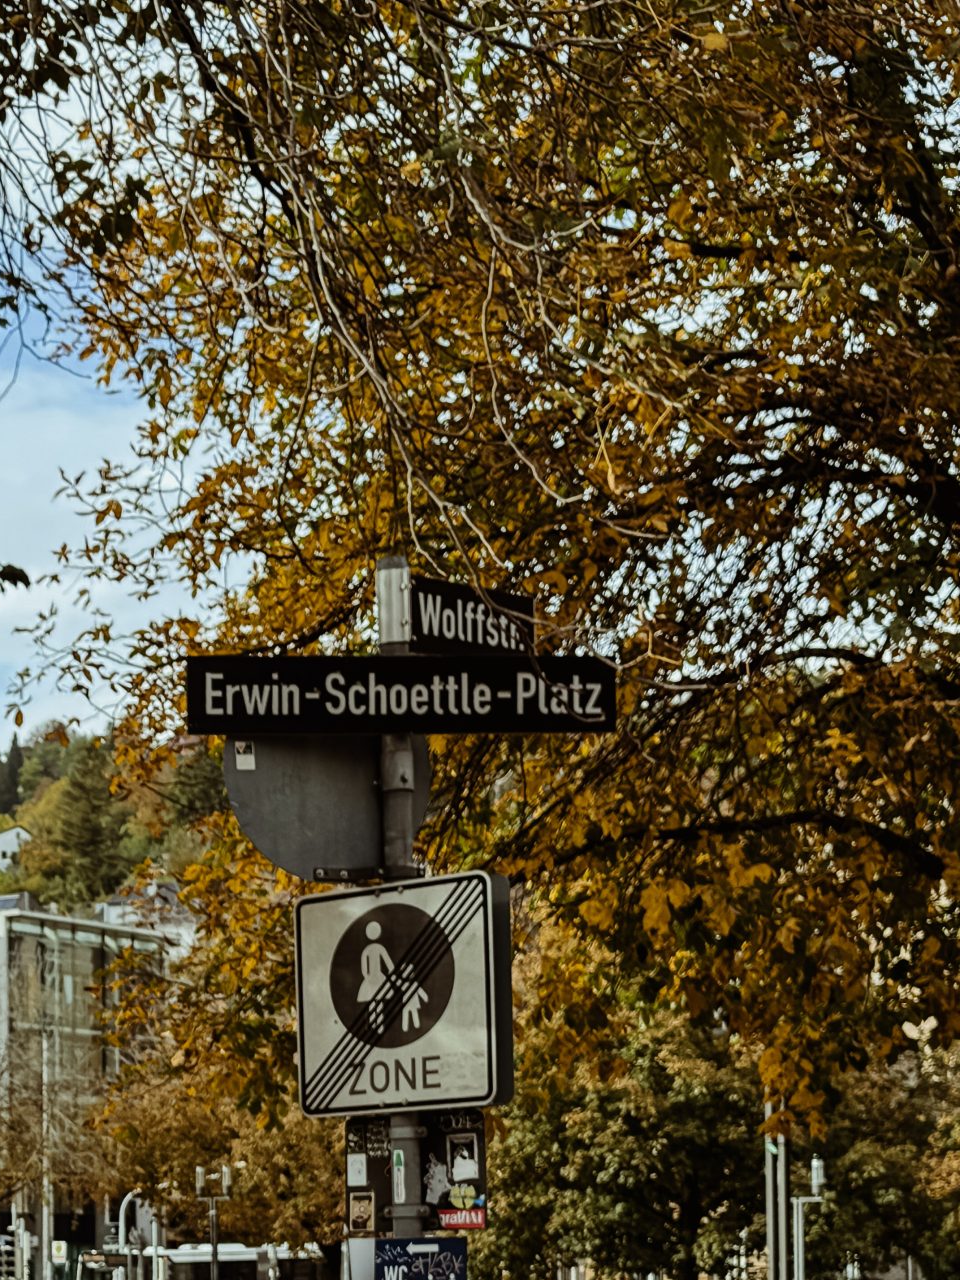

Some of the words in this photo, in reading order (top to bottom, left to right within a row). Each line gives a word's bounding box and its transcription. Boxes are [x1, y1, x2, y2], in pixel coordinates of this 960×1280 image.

[418, 593, 525, 650] Wolffstr.
[205, 671, 602, 715] Erwin-Schoettle-Platz
[348, 1055, 442, 1096] ZONE
